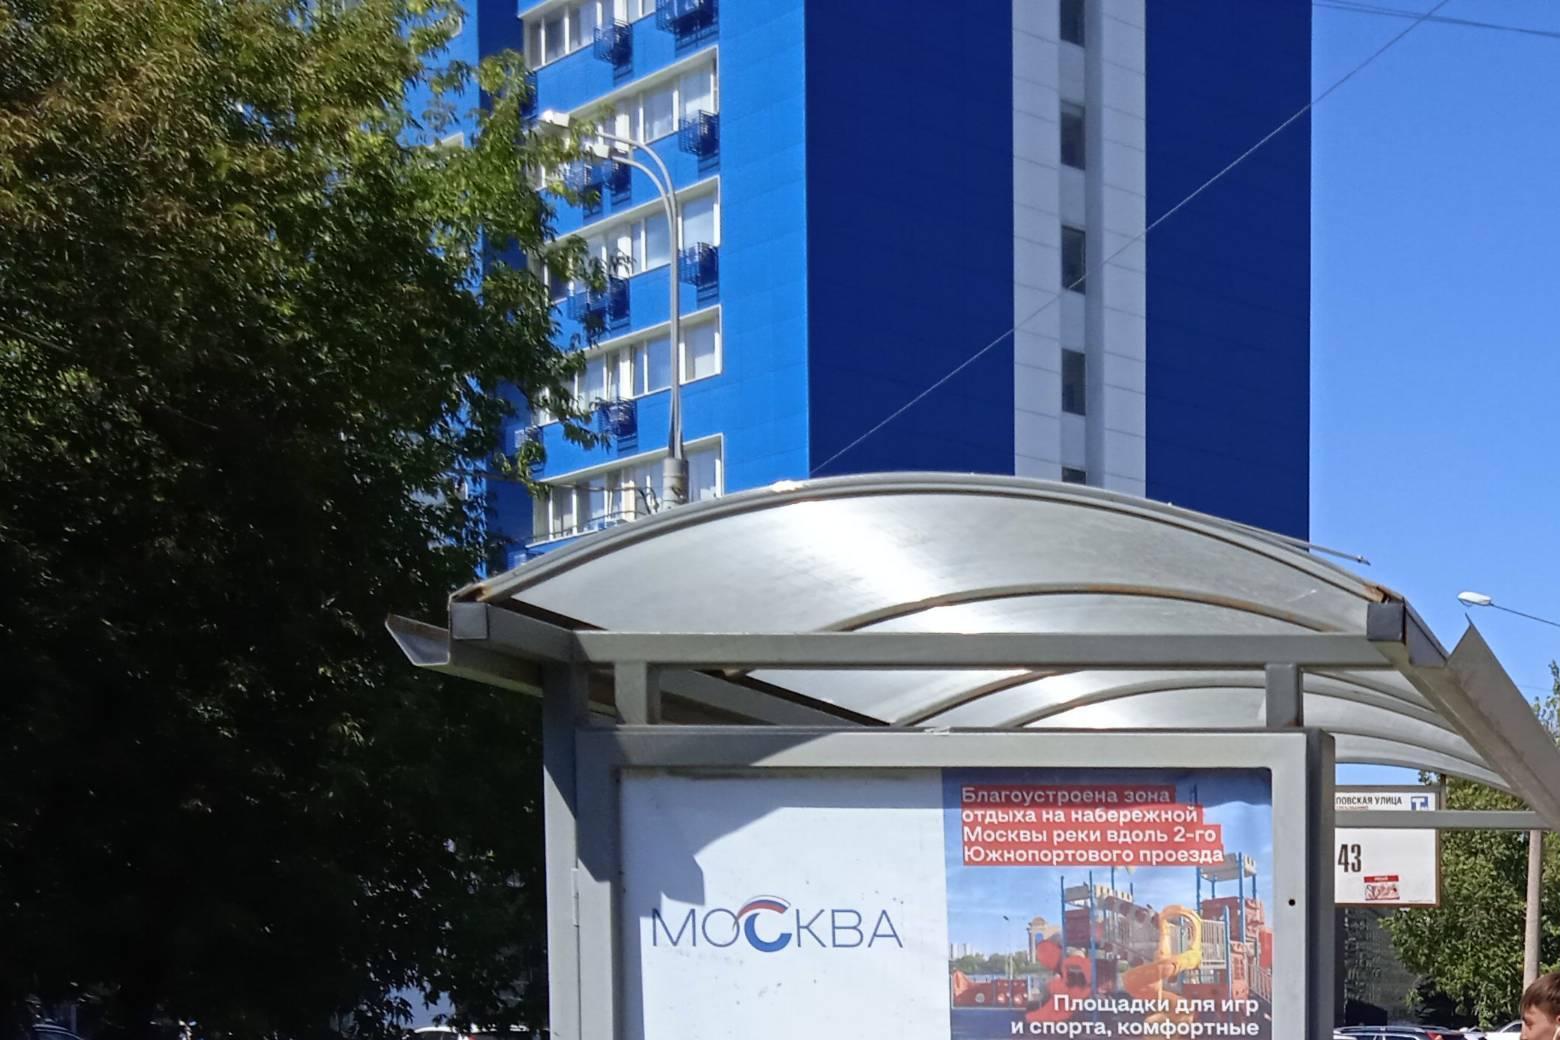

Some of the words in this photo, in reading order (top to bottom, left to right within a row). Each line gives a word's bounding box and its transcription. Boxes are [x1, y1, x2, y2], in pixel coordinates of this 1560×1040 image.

[961, 787, 1118, 806] Благоустроена
[1124, 790, 1169, 803] зона
[1375, 797, 1402, 805] УЛИЦА
[962, 809, 1036, 823] отдыха
[1042, 810, 1065, 822] на
[1071, 806, 1197, 824] набережной
[964, 827, 1047, 842] Москвы
[1053, 829, 1100, 845] реки
[1107, 831, 1168, 844] вдоль
[1173, 827, 1216, 841] 2-го
[964, 847, 1134, 864] Южнопортового
[1139, 850, 1224, 864] проезда
[1338, 844, 1361, 872] 43
[652, 895, 903, 952] МОСКВА
[1053, 994, 1169, 1014] Площадки
[1175, 999, 1215, 1014] для
[1221, 999, 1259, 1015] игр
[1011, 1022, 1024, 1034] и
[1030, 1022, 1111, 1038] спорта,
[1118, 1021, 1259, 1039] комфортные
